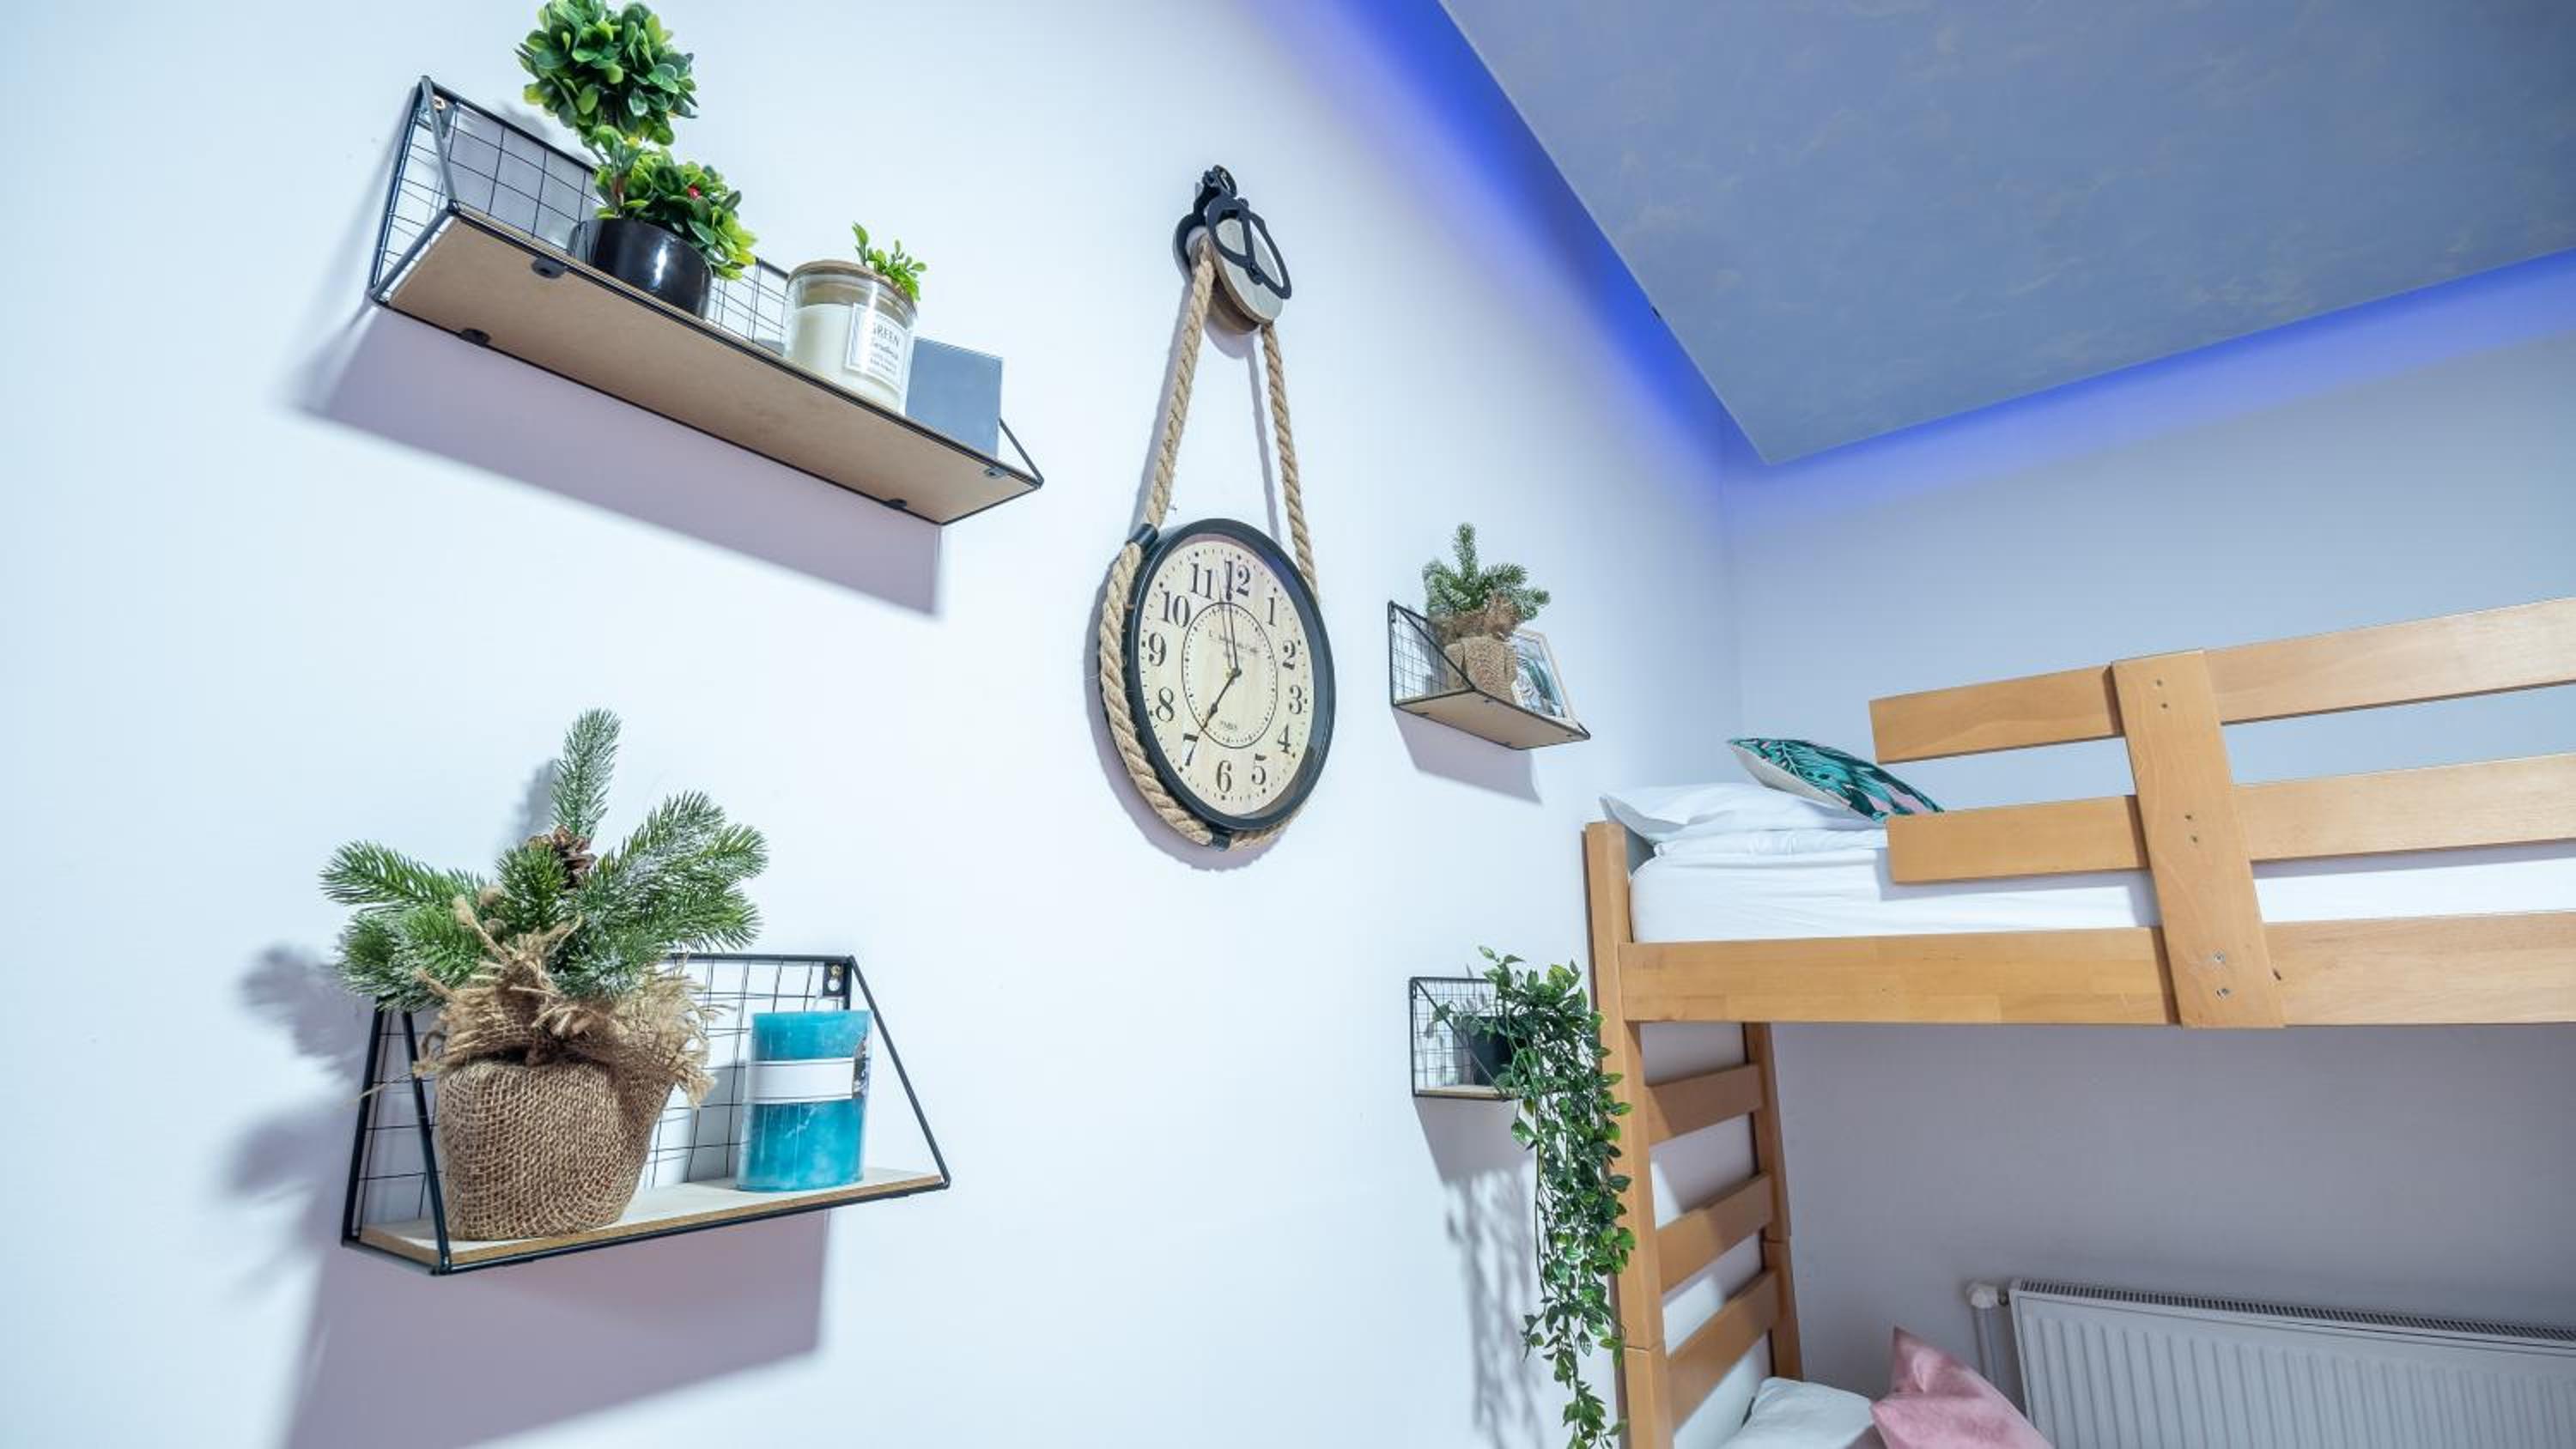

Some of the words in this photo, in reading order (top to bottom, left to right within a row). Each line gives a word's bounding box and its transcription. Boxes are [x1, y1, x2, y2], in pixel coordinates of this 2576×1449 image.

[1190, 562, 1212, 600] 11
[1225, 561, 1251, 598] 12
[1162, 591, 1190, 628] 10
[1267, 597, 1275, 627] 1
[1148, 633, 1167, 667] 9
[1283, 640, 1296, 670] 2
[1155, 687, 1175, 722] 8
[1289, 684, 1303, 715] 3
[1182, 732, 1199, 767] 7
[1277, 724, 1291, 755] 4
[1216, 760, 1232, 793] 6
[1251, 753, 1267, 785] 5
